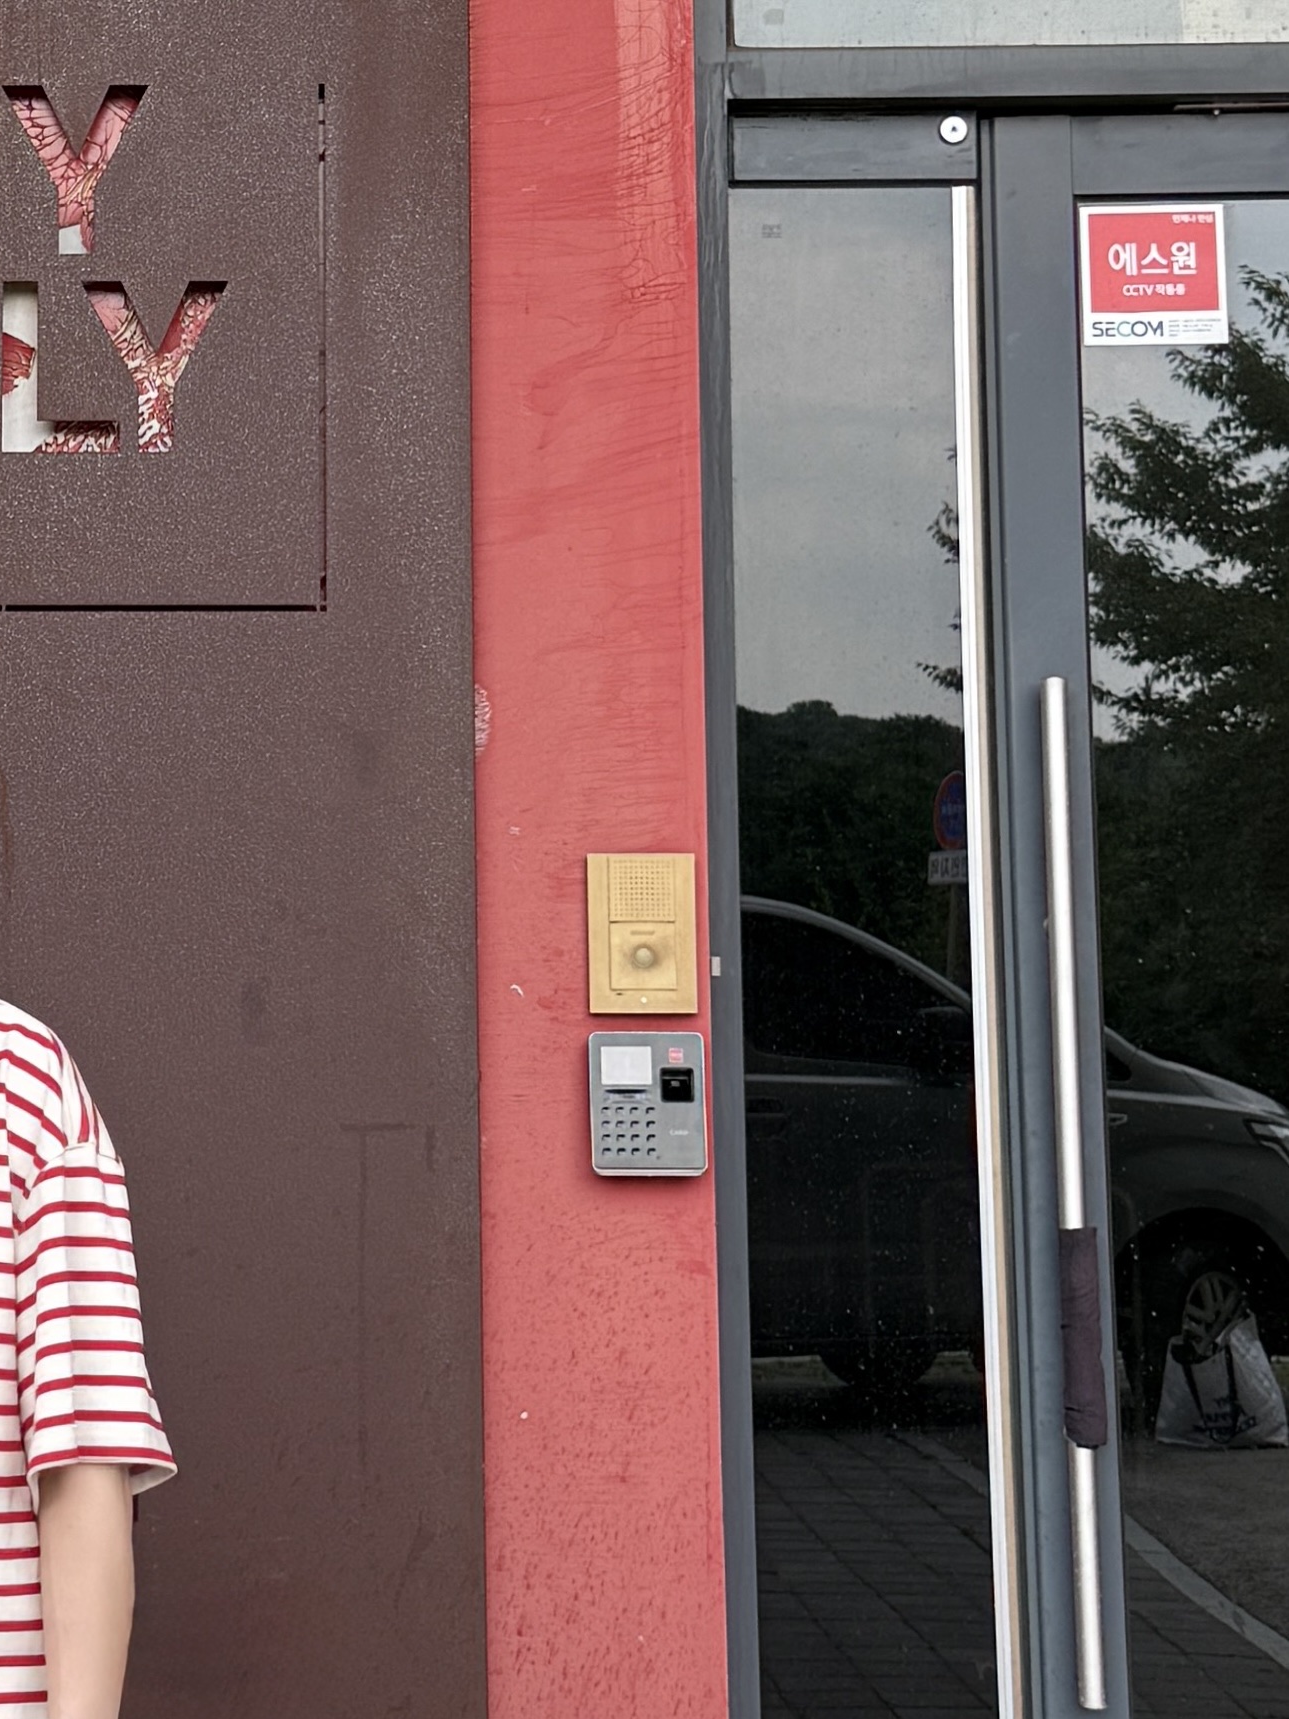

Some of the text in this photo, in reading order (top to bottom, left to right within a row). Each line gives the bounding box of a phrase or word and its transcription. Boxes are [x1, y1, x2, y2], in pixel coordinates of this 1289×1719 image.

[1107, 241, 1197, 276] 에스원
[1122, 284, 1154, 297] CCTV
[1091, 320, 1164, 338] SECOM
